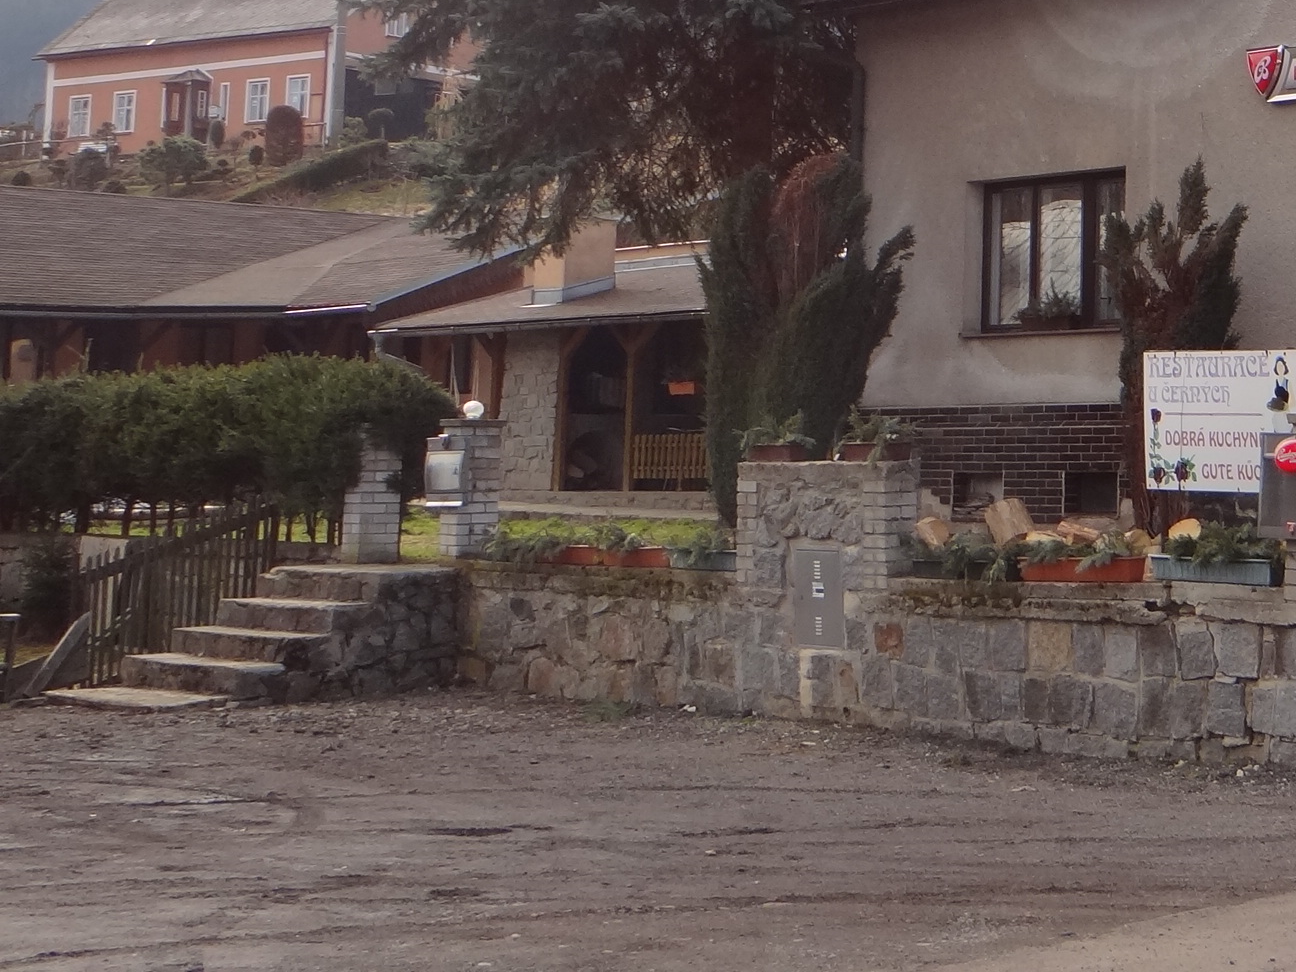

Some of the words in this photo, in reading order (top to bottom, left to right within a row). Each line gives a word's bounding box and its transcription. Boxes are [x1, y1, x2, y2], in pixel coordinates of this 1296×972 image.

[1165, 427, 1205, 446] DOBRÁ
[1209, 428, 1264, 448] KUCHYN
[1201, 463, 1233, 480] GUTE
[1237, 460, 1261, 481] KÜC
